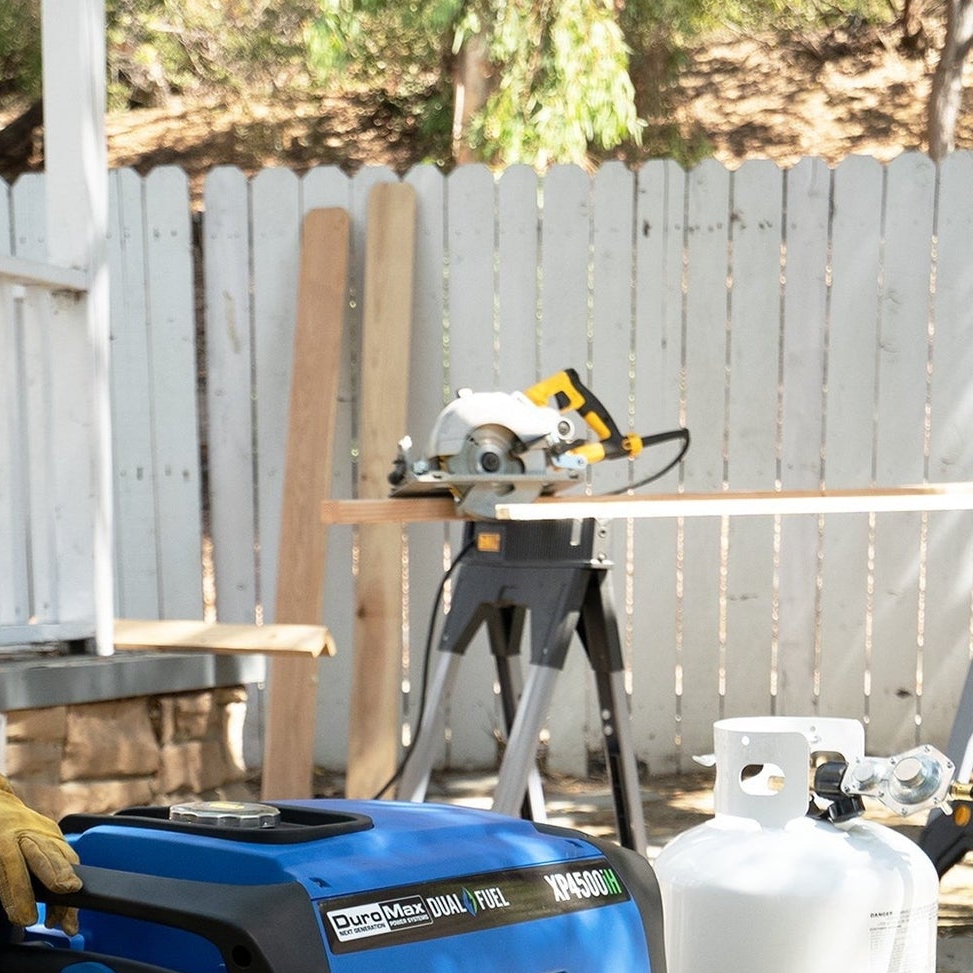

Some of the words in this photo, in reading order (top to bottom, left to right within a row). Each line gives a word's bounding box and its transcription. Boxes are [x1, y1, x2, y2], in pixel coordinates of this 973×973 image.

[544, 868, 622, 902] XP4500iH
[426, 894, 467, 918] DUAL
[474, 888, 510, 910] FUEL
[354, 923, 386, 934] GENERATION
